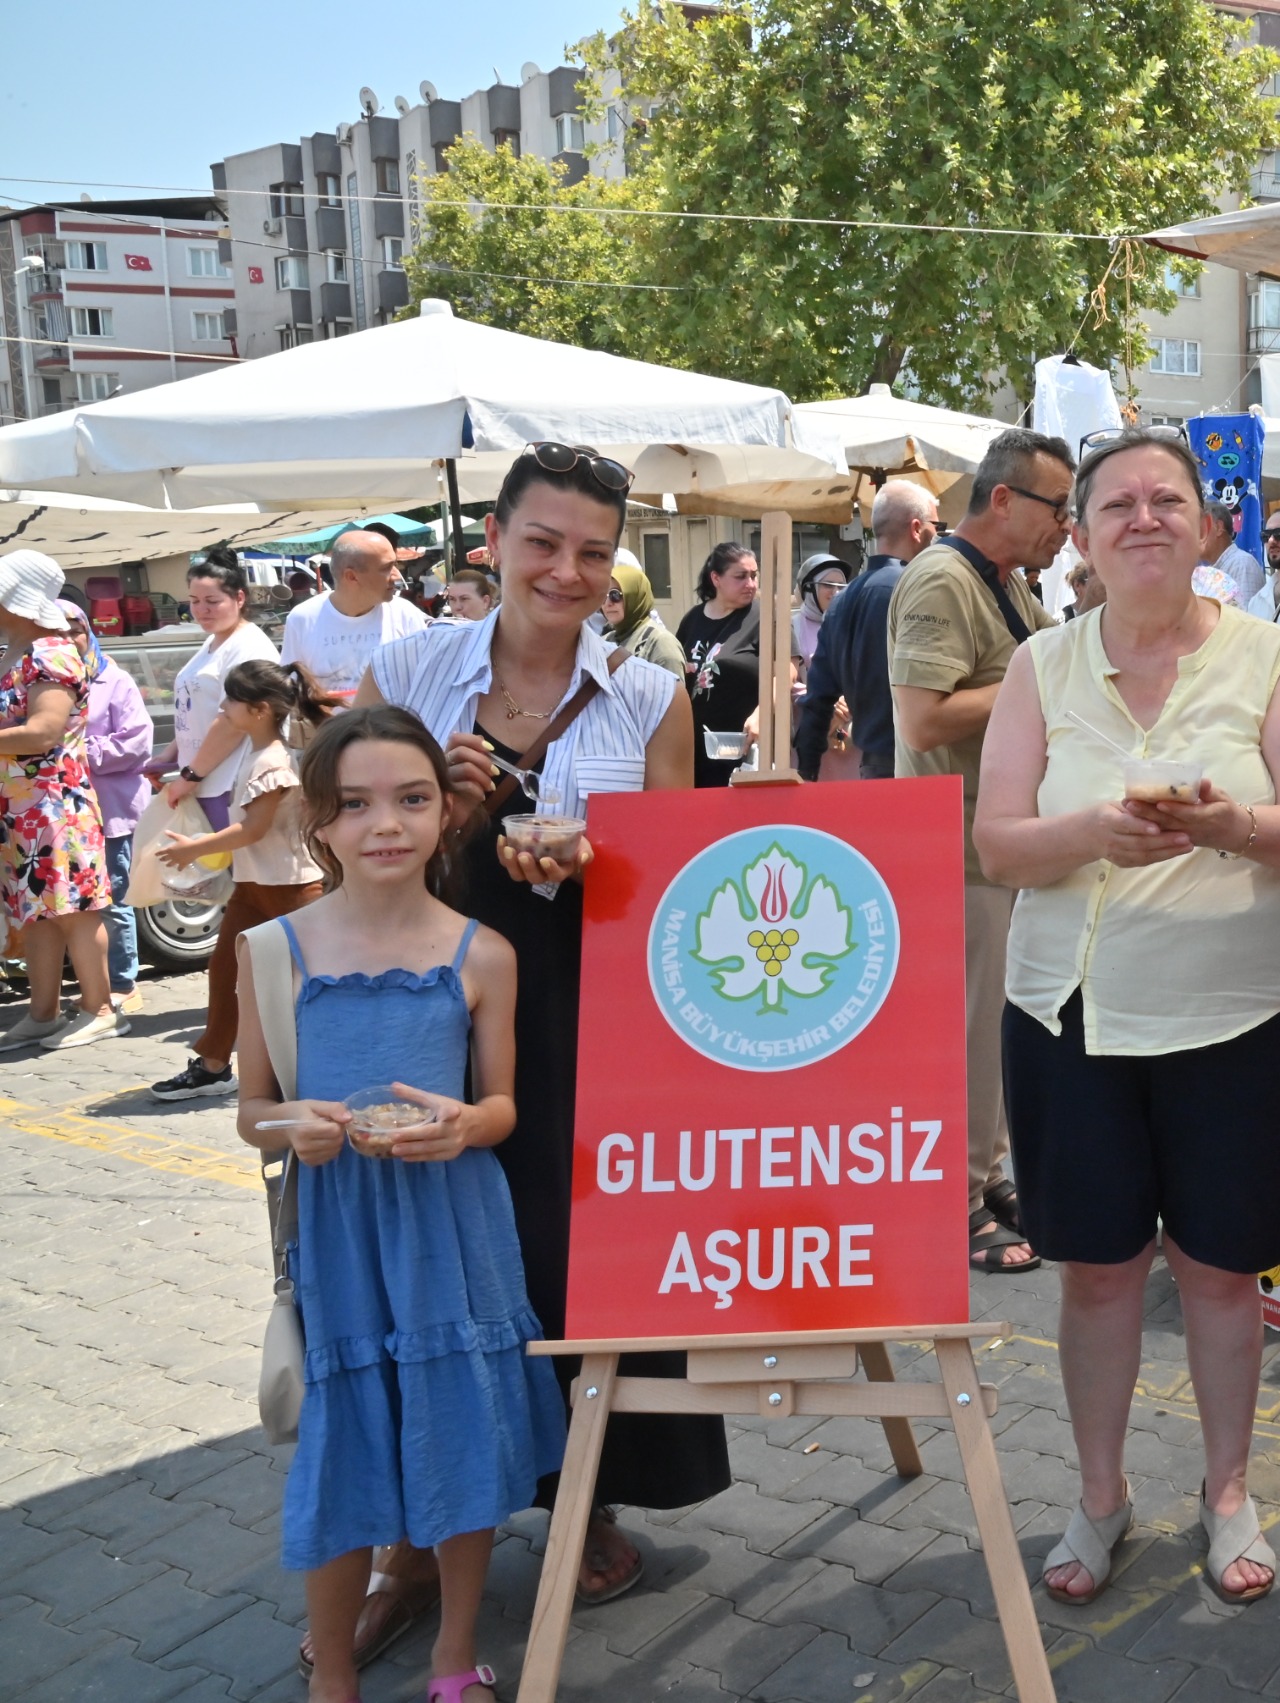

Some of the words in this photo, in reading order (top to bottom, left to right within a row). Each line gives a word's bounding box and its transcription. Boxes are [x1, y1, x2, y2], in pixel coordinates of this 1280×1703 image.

[661, 907, 687, 1006] MANİSA
[679, 1000, 832, 1063] BÜYÜKŞEHİR
[827, 898, 886, 1033] BELEDİYESİ
[596, 1105, 944, 1195] GLUTENSİZ
[657, 1222, 874, 1310] AŞURE
